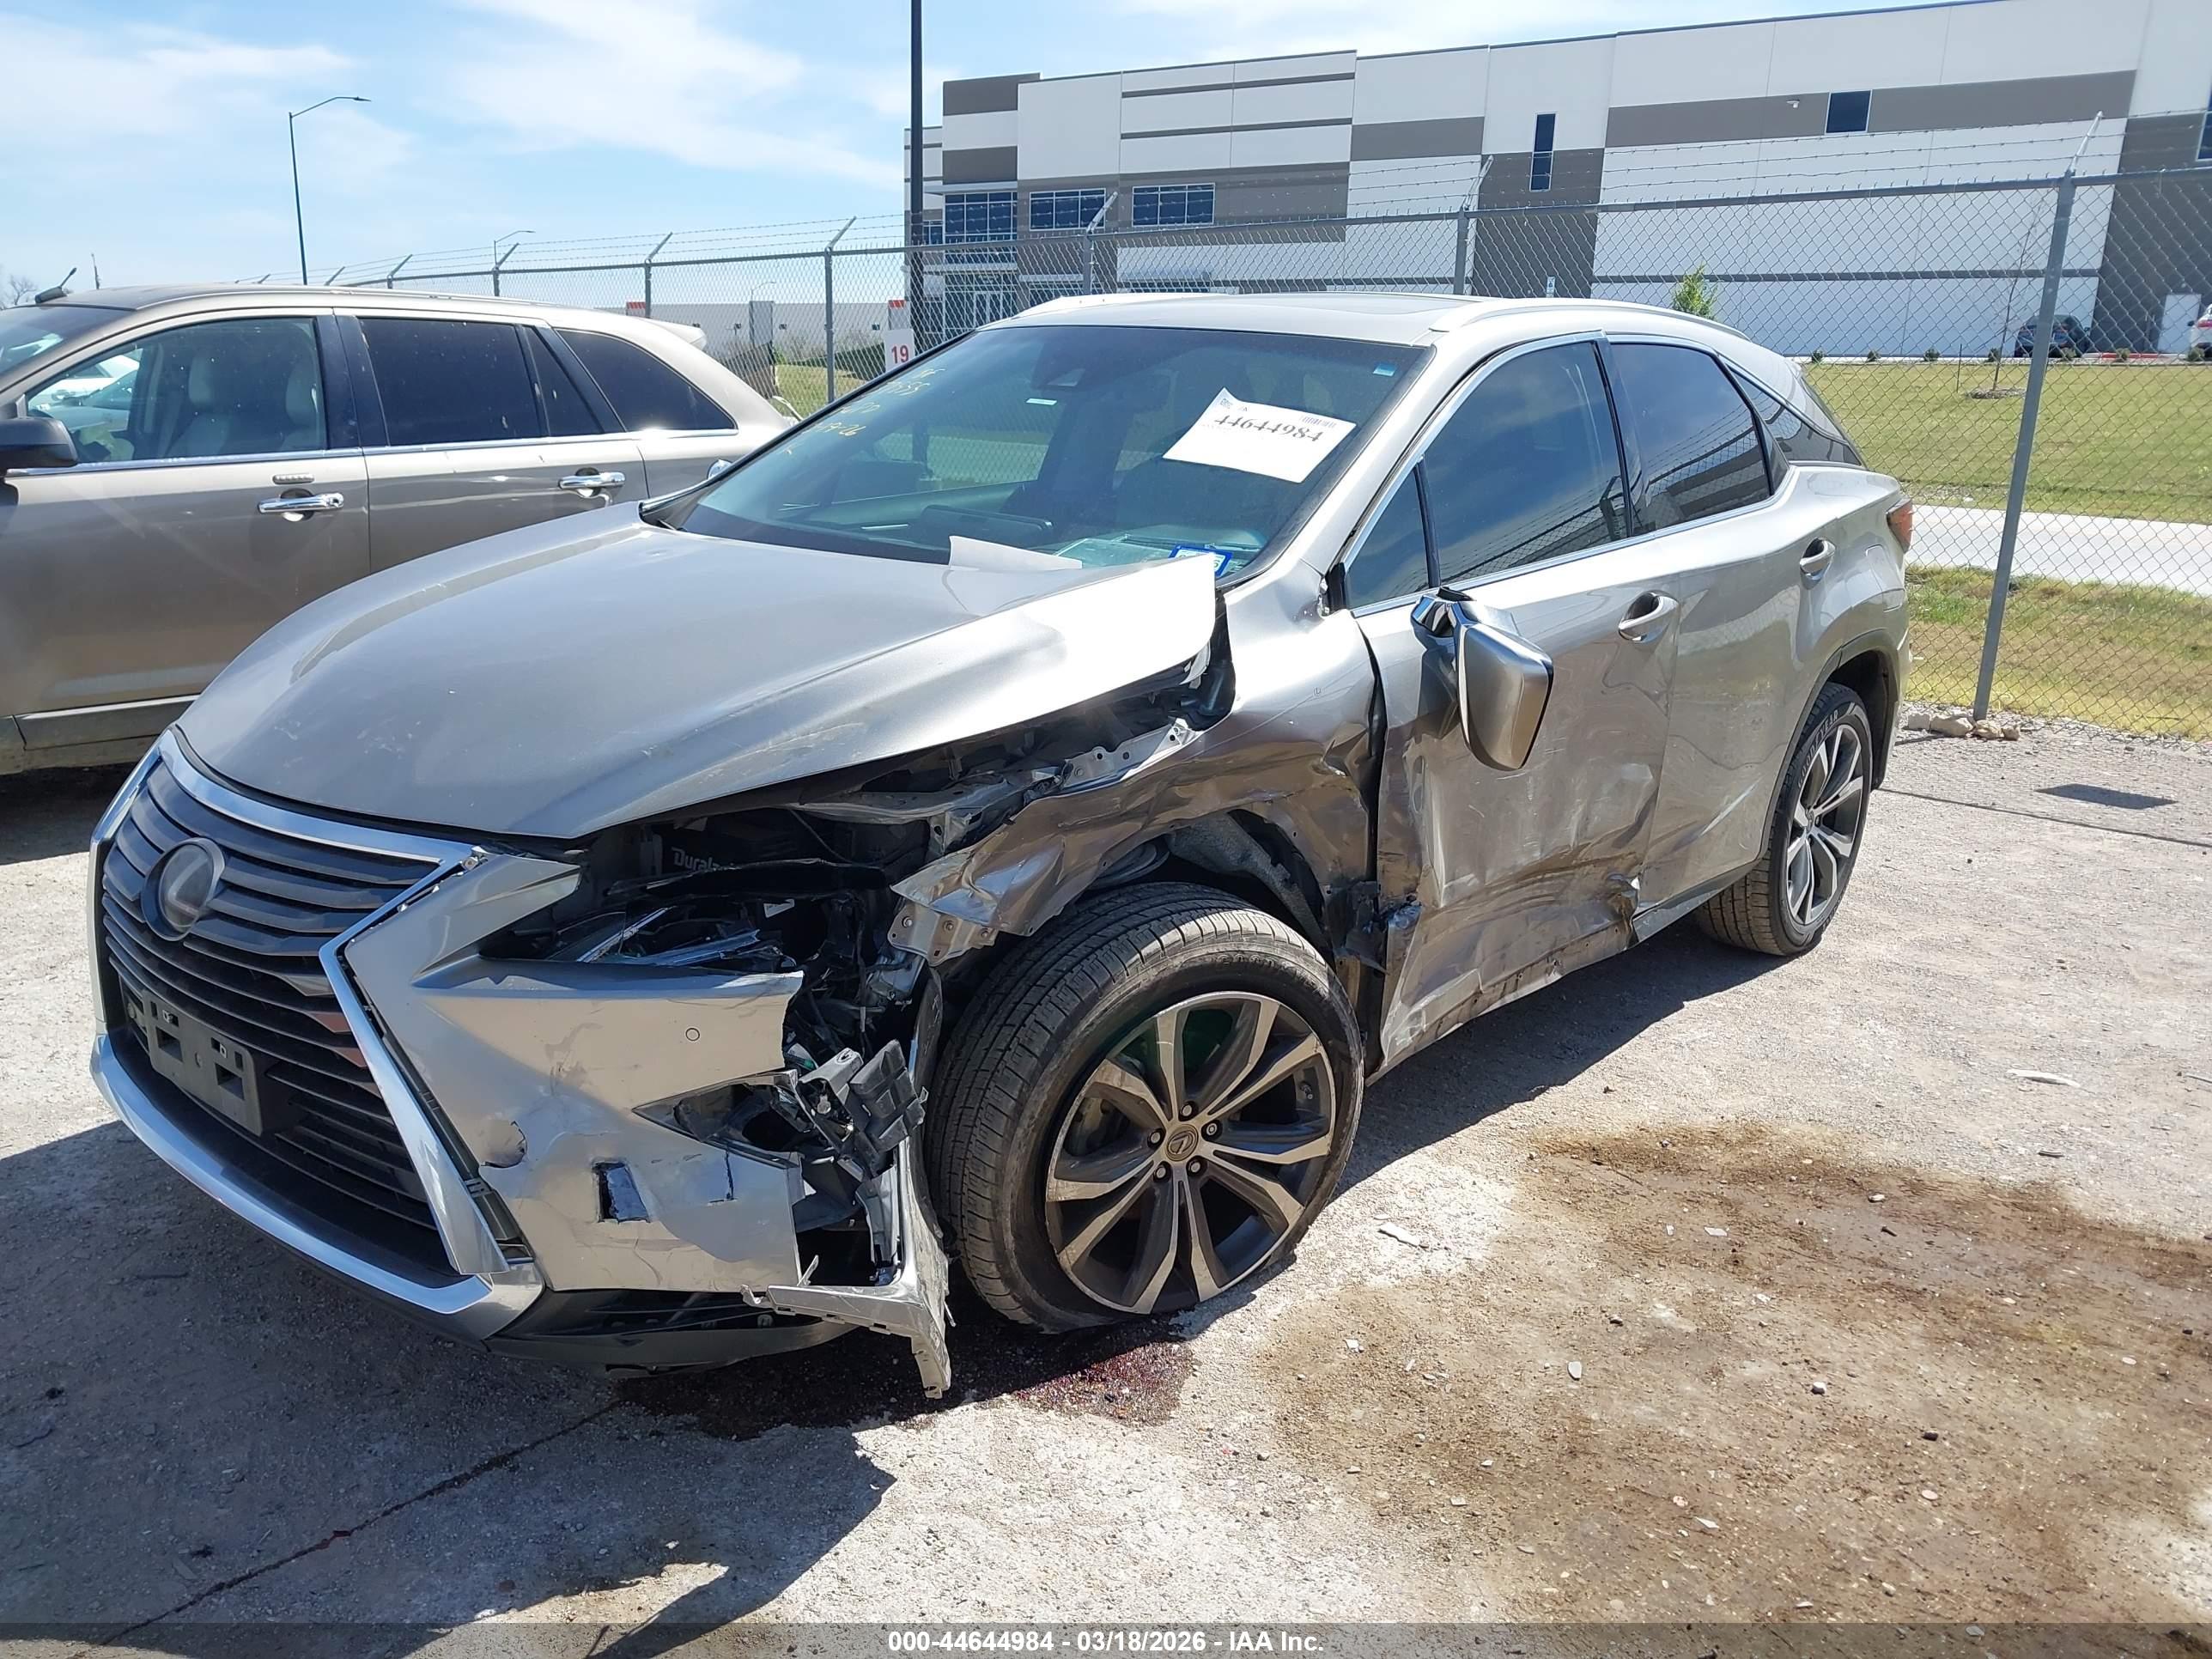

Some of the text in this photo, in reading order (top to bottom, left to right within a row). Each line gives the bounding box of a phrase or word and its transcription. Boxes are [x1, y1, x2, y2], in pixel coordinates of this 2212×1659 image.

[891, 345, 908, 364] 19
[1214, 415, 1324, 442] 44644984
[672, 846, 737, 874] Dural
